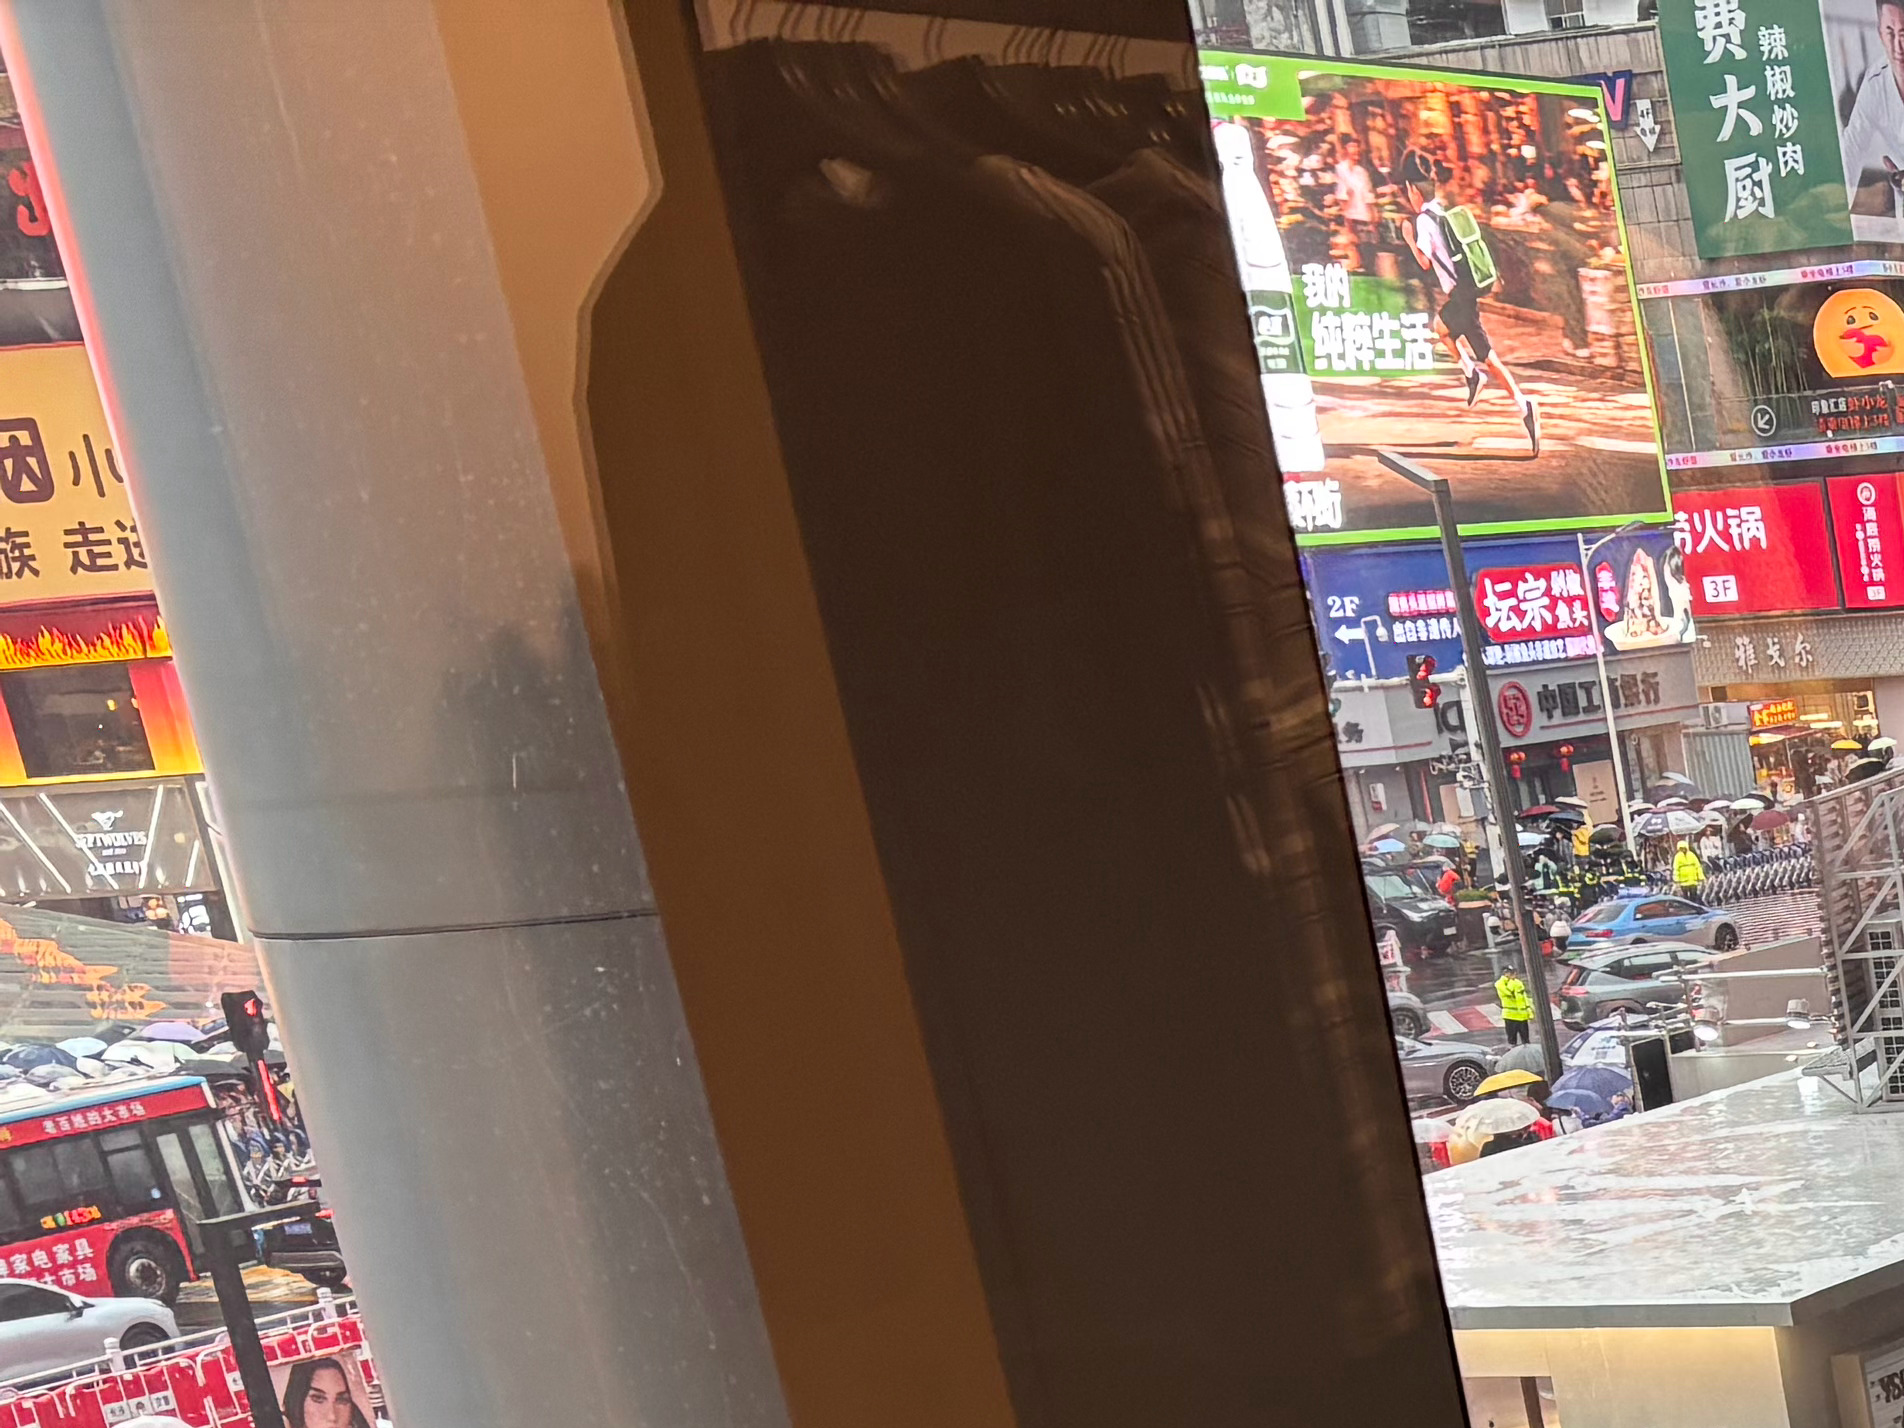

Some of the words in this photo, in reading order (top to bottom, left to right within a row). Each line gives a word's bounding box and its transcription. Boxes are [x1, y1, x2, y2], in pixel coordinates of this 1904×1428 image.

[1757, 26, 1805, 178] 辣椒炒肉
[1327, 596, 1360, 618] 2F
[1483, 572, 1553, 633] 坛宗
[1734, 633, 1814, 674] 雅戈尔
